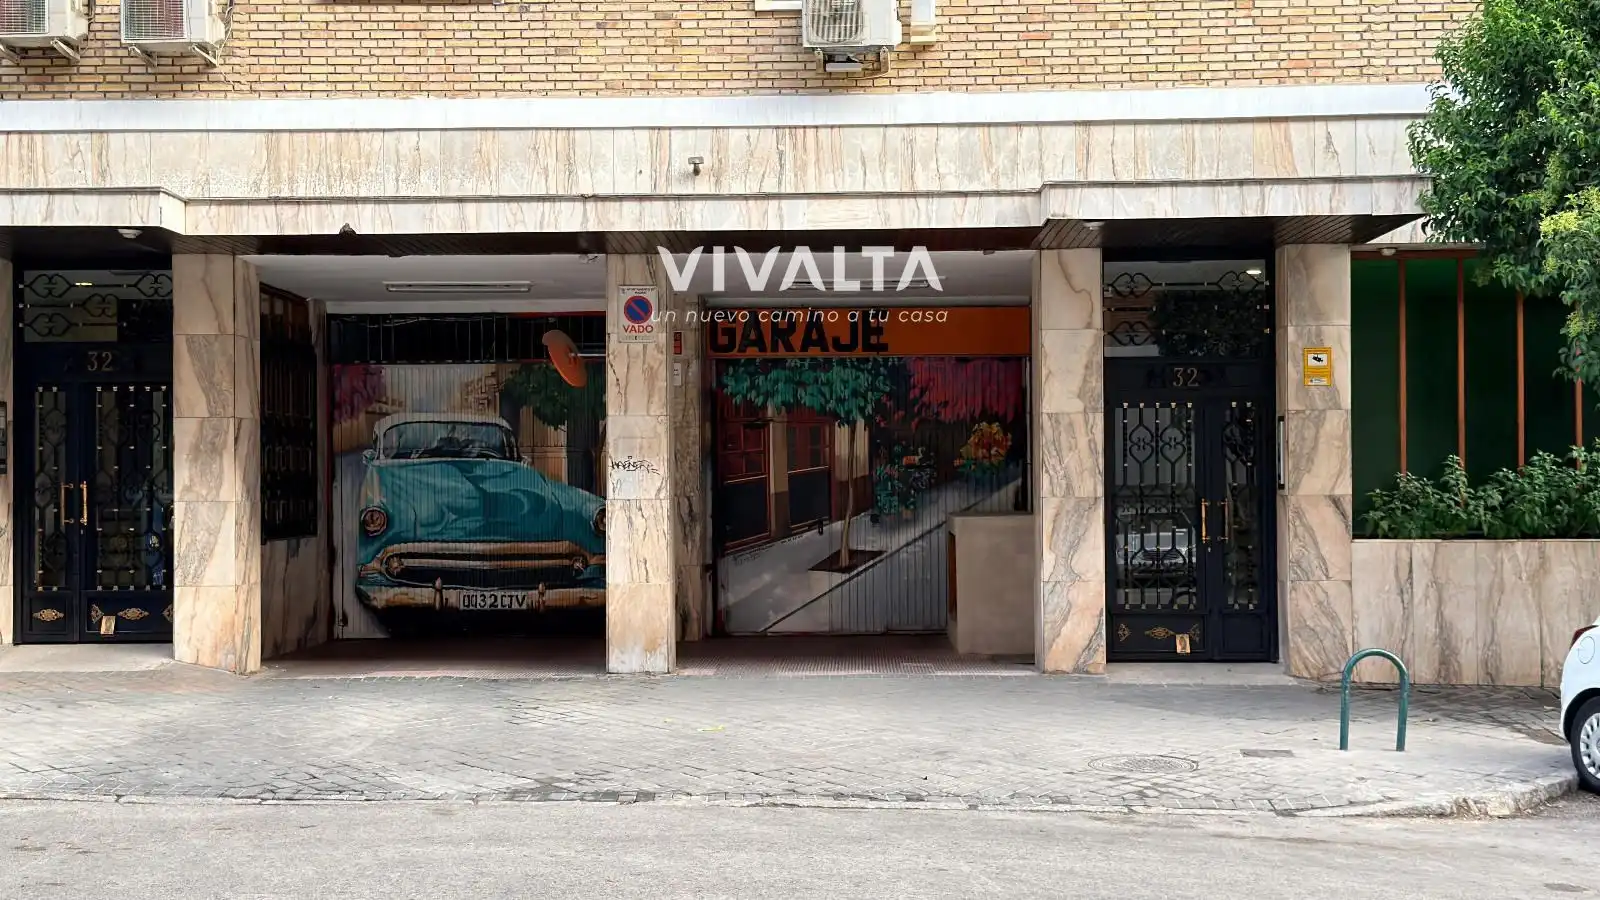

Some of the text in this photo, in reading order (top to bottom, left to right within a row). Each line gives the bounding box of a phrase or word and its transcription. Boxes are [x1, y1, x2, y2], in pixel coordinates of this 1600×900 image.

[623, 324, 654, 334] VADO
[710, 310, 889, 353] GARAJE
[87, 351, 114, 372] 32
[1172, 367, 1200, 387] 32
